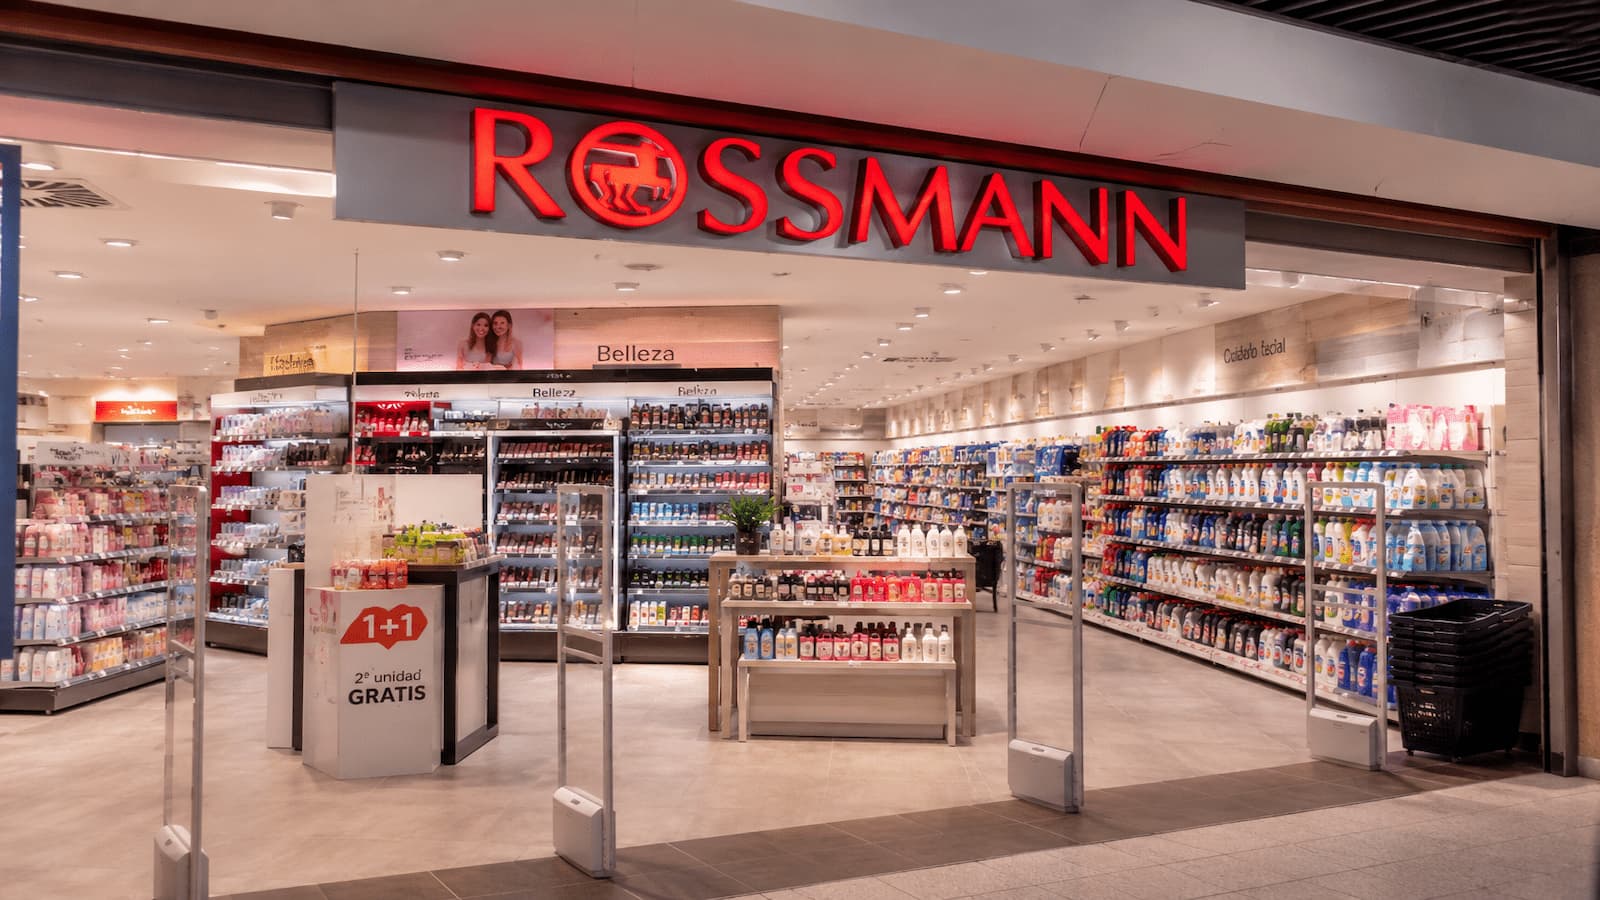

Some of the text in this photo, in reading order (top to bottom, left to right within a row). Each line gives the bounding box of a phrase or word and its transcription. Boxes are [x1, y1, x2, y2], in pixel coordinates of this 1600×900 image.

[470, 107, 1188, 272] ROSSMANN
[597, 344, 675, 362] Belleza
[362, 612, 414, 639] 1+1
[374, 669, 422, 682] unidad
[348, 685, 426, 705] GRATIS
